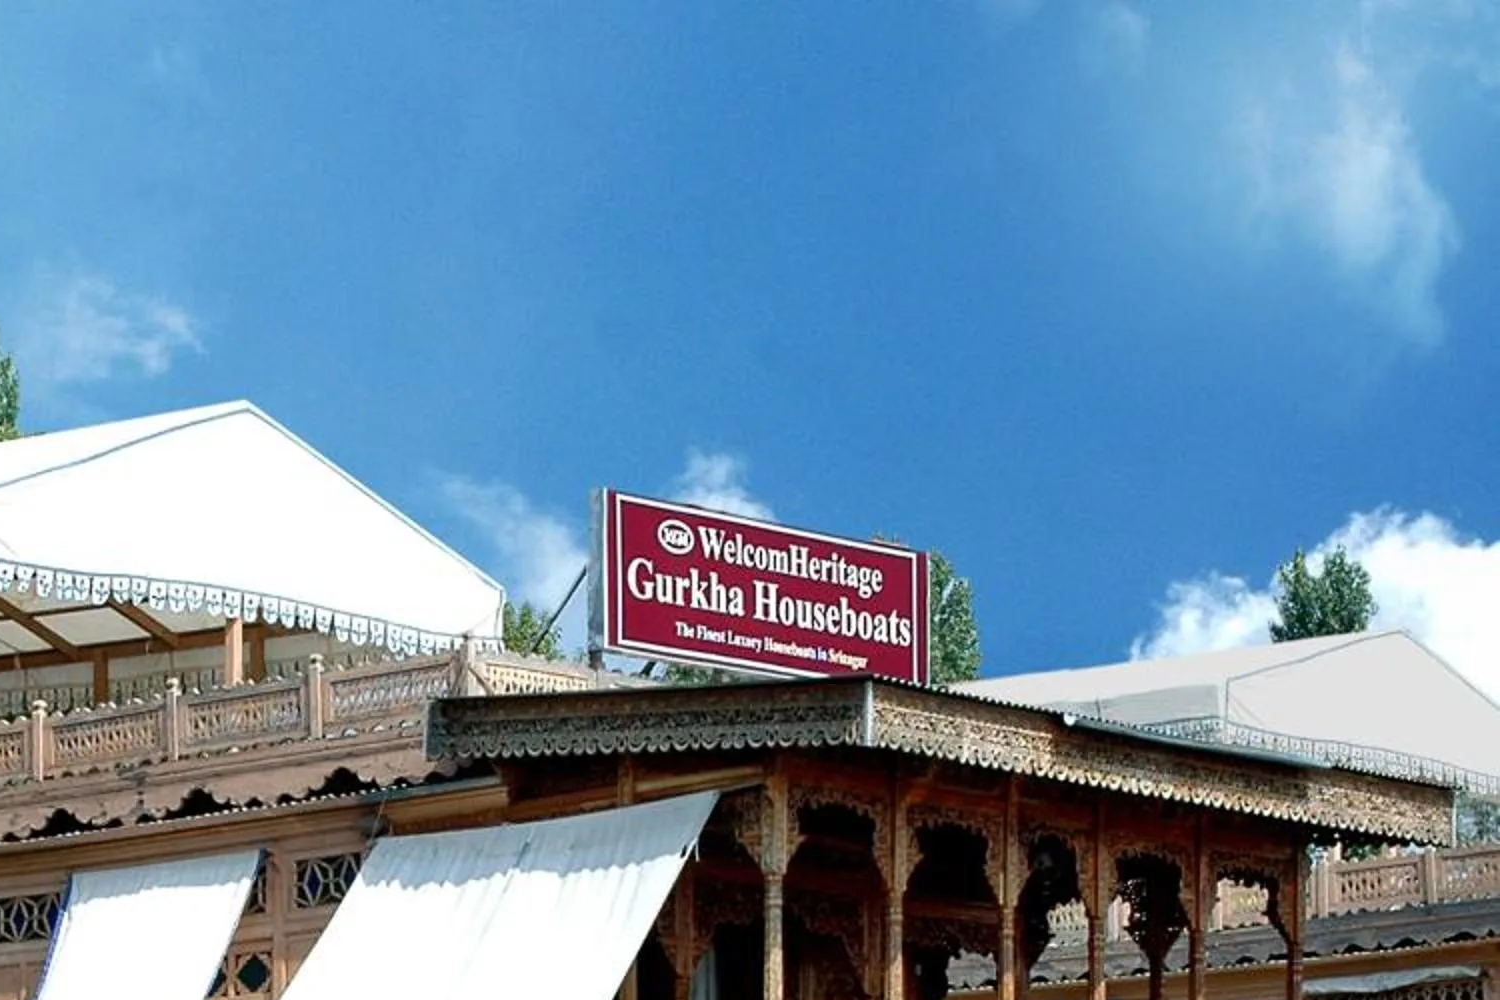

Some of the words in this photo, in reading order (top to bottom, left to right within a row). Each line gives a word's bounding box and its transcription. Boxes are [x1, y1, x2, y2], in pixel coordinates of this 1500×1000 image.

[697, 525, 884, 599] WelcomHeritage
[627, 557, 745, 618] Gurkha
[752, 578, 912, 647] Houseboats
[675, 621, 694, 639] The
[696, 624, 727, 644] Finest
[727, 629, 764, 653] Luxury
[764, 637, 817, 660] Houseboats
[817, 645, 828, 662] in
[828, 648, 869, 671] Srinagar
